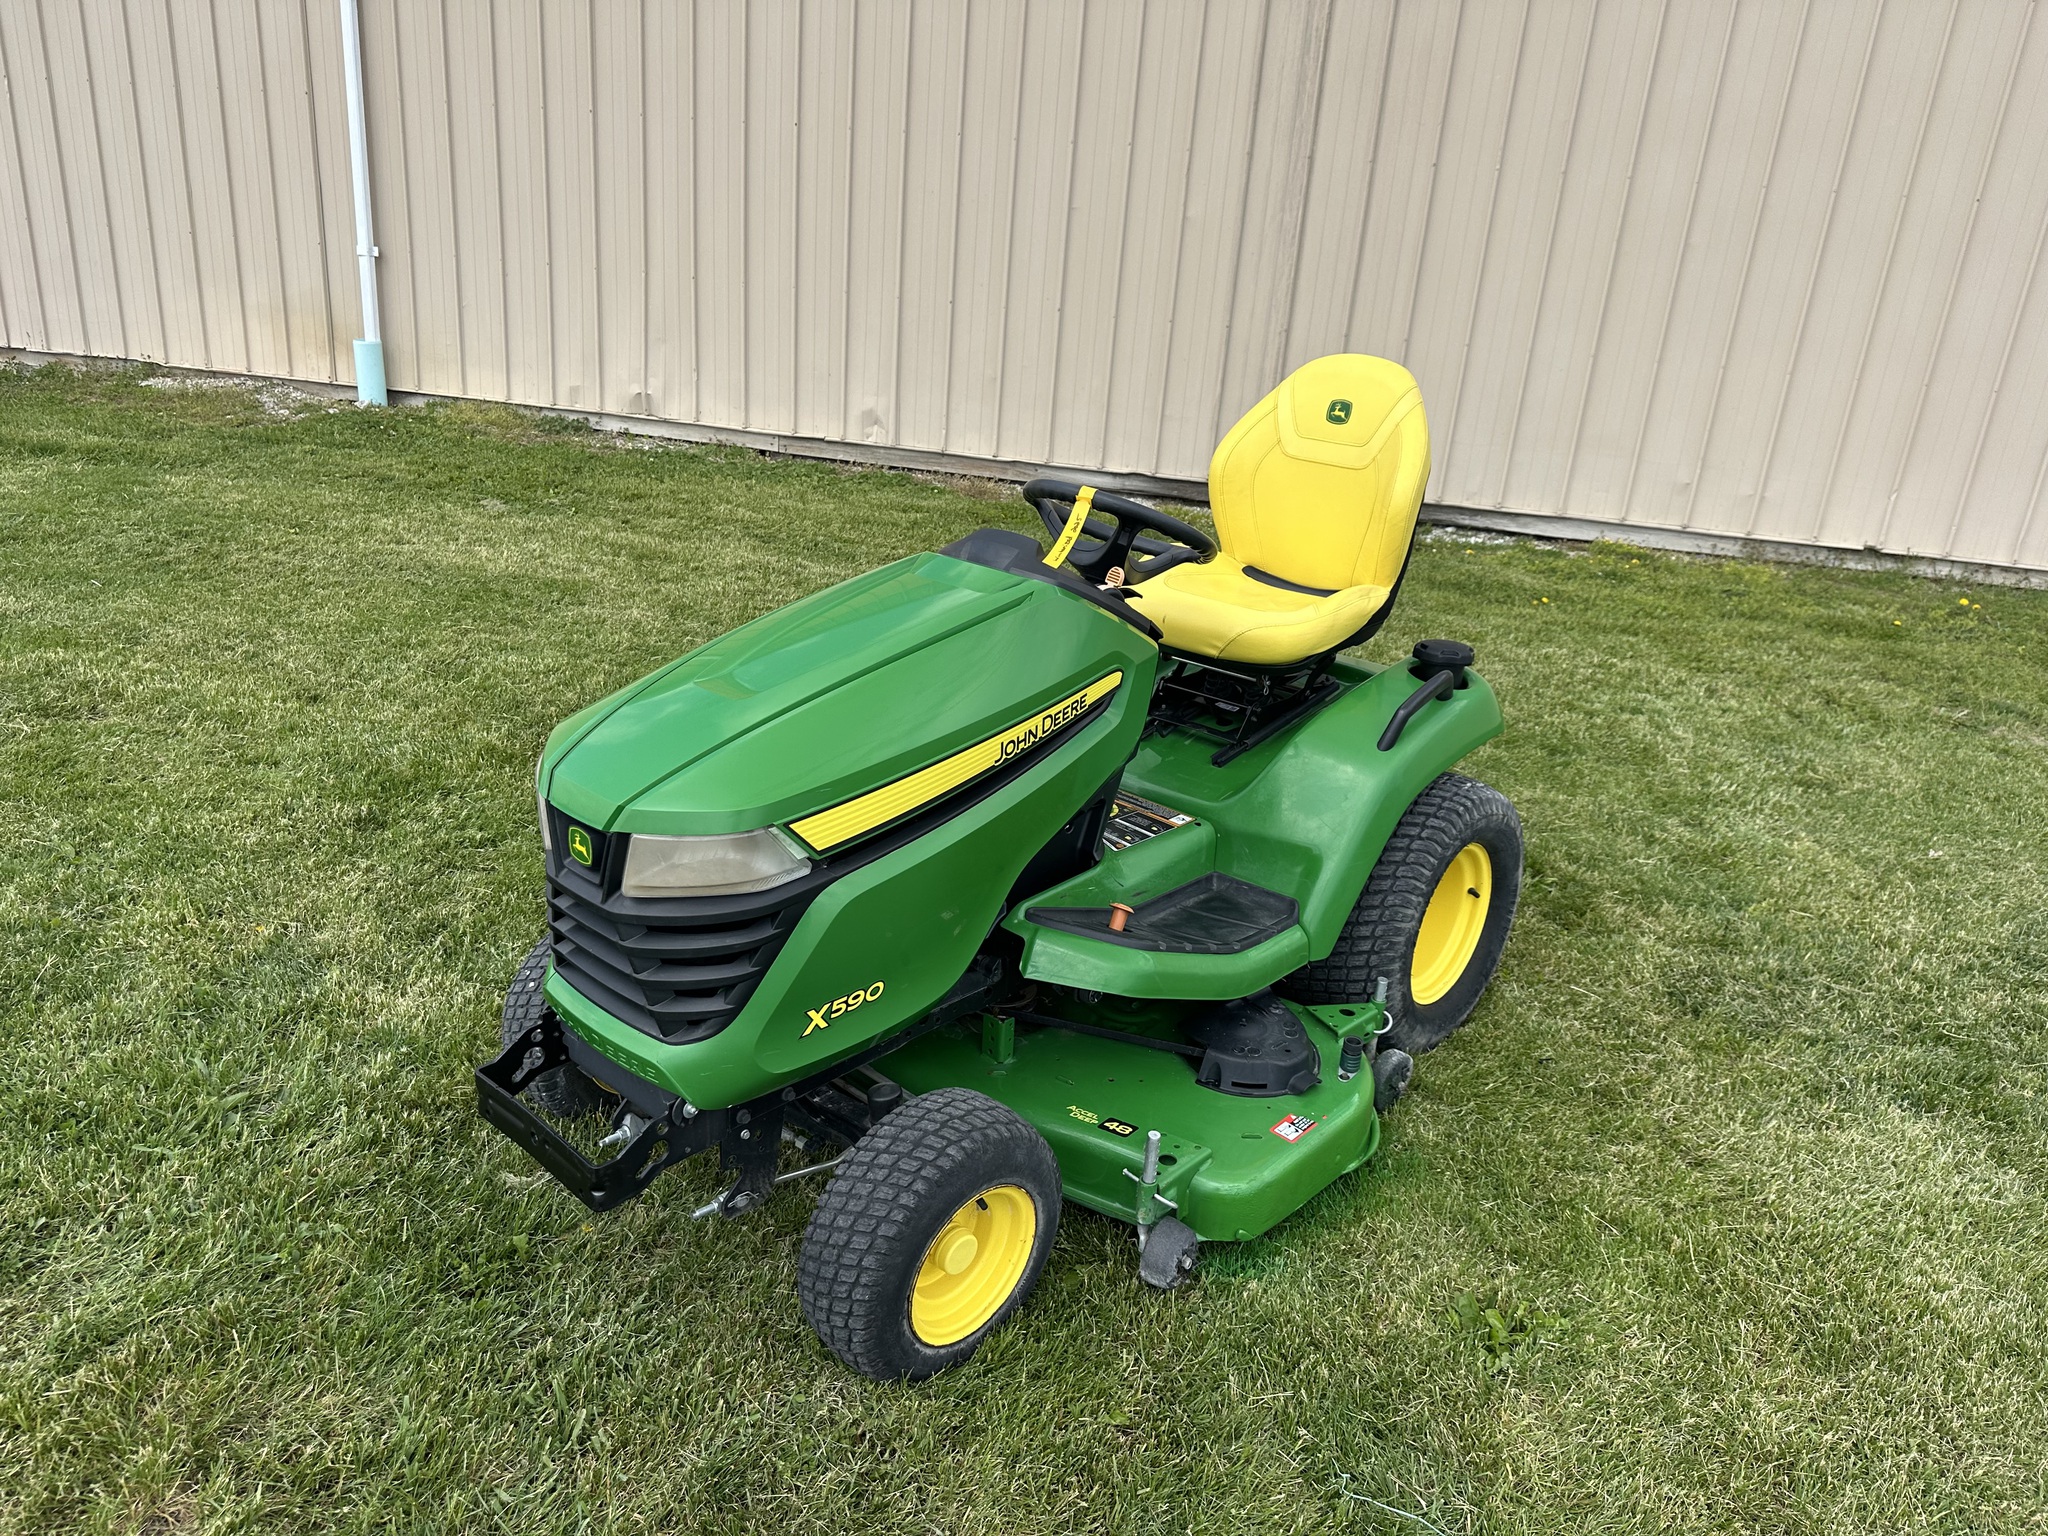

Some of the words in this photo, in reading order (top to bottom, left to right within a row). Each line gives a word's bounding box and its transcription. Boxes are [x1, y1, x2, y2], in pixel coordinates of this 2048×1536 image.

[994, 725, 1039, 766] JOHN
[1041, 692, 1089, 737] DEERE
[799, 980, 885, 1039] X590
[1066, 1105, 1098, 1119] ACCEL
[1069, 1111, 1099, 1124] DEEP
[1103, 1121, 1133, 1135] 48
